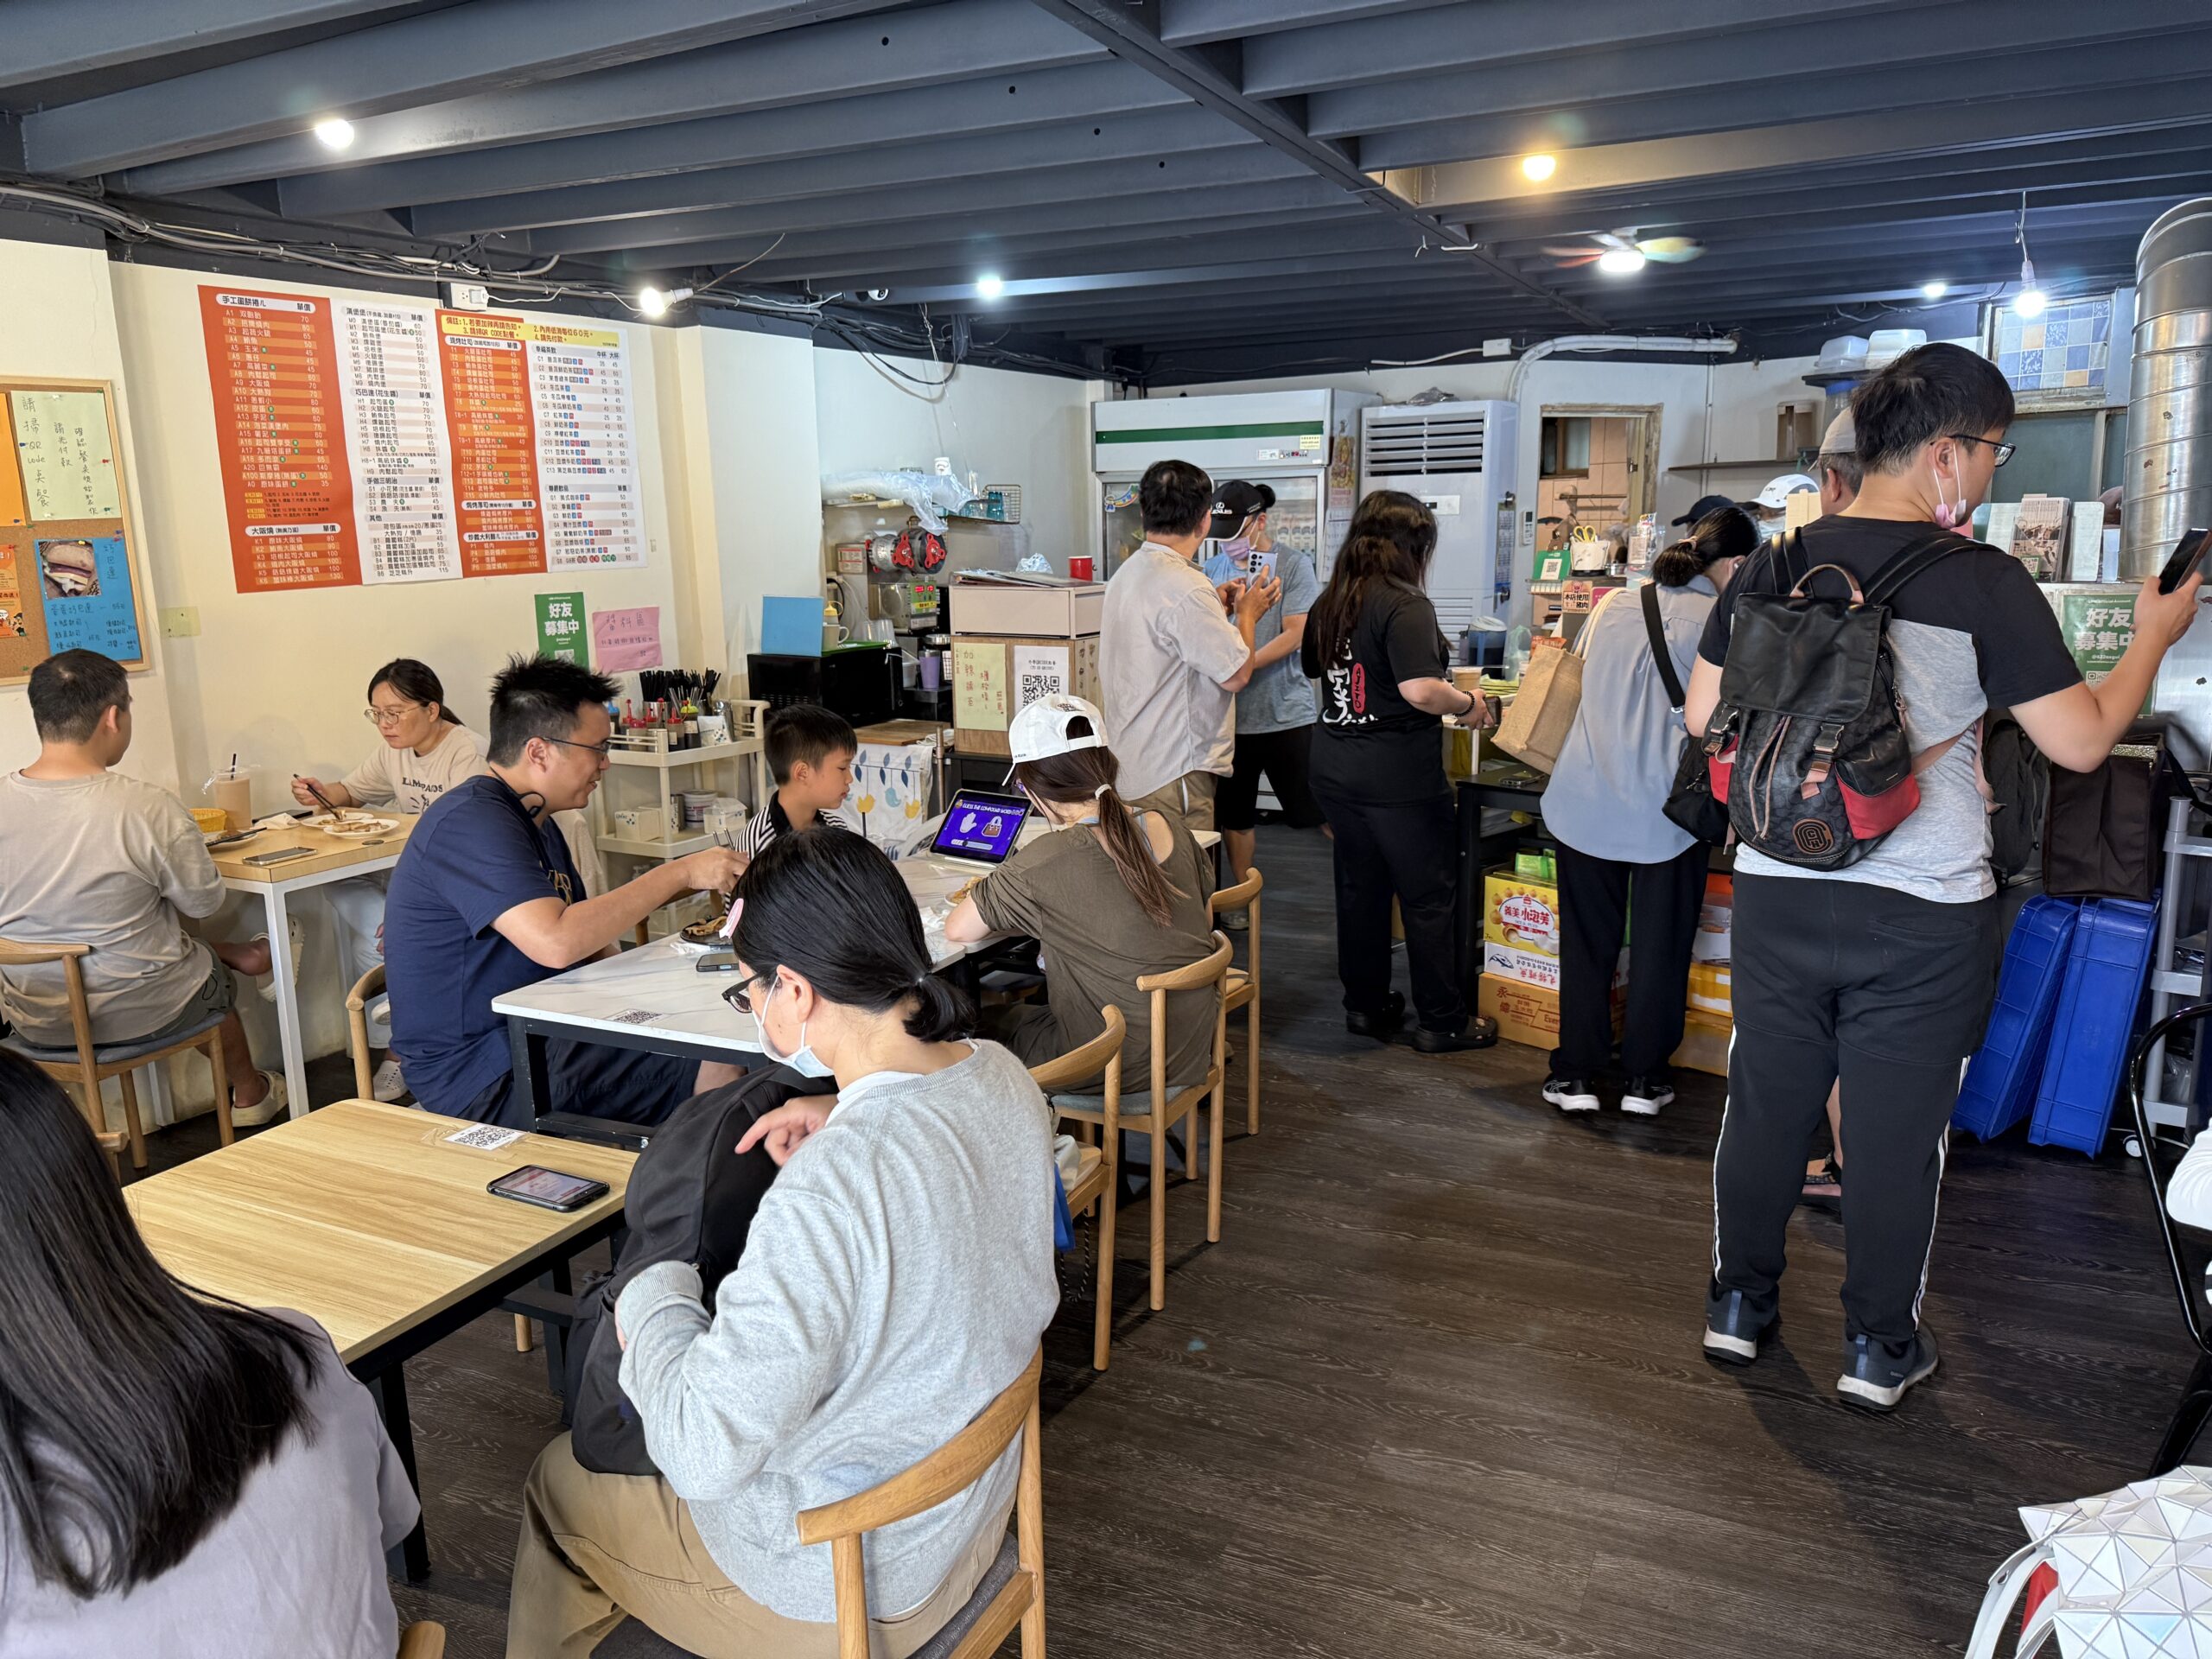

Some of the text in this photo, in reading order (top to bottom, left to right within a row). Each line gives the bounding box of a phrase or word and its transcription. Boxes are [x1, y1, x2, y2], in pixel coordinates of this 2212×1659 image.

[296, 303, 311, 312] 單價
[449, 337, 473, 346] 現烤吐司
[549, 602, 572, 618] 好友
[2086, 607, 2133, 628] 好友
[544, 620, 580, 636] 募集中
[1521, 907, 1550, 926] 小泡芙
